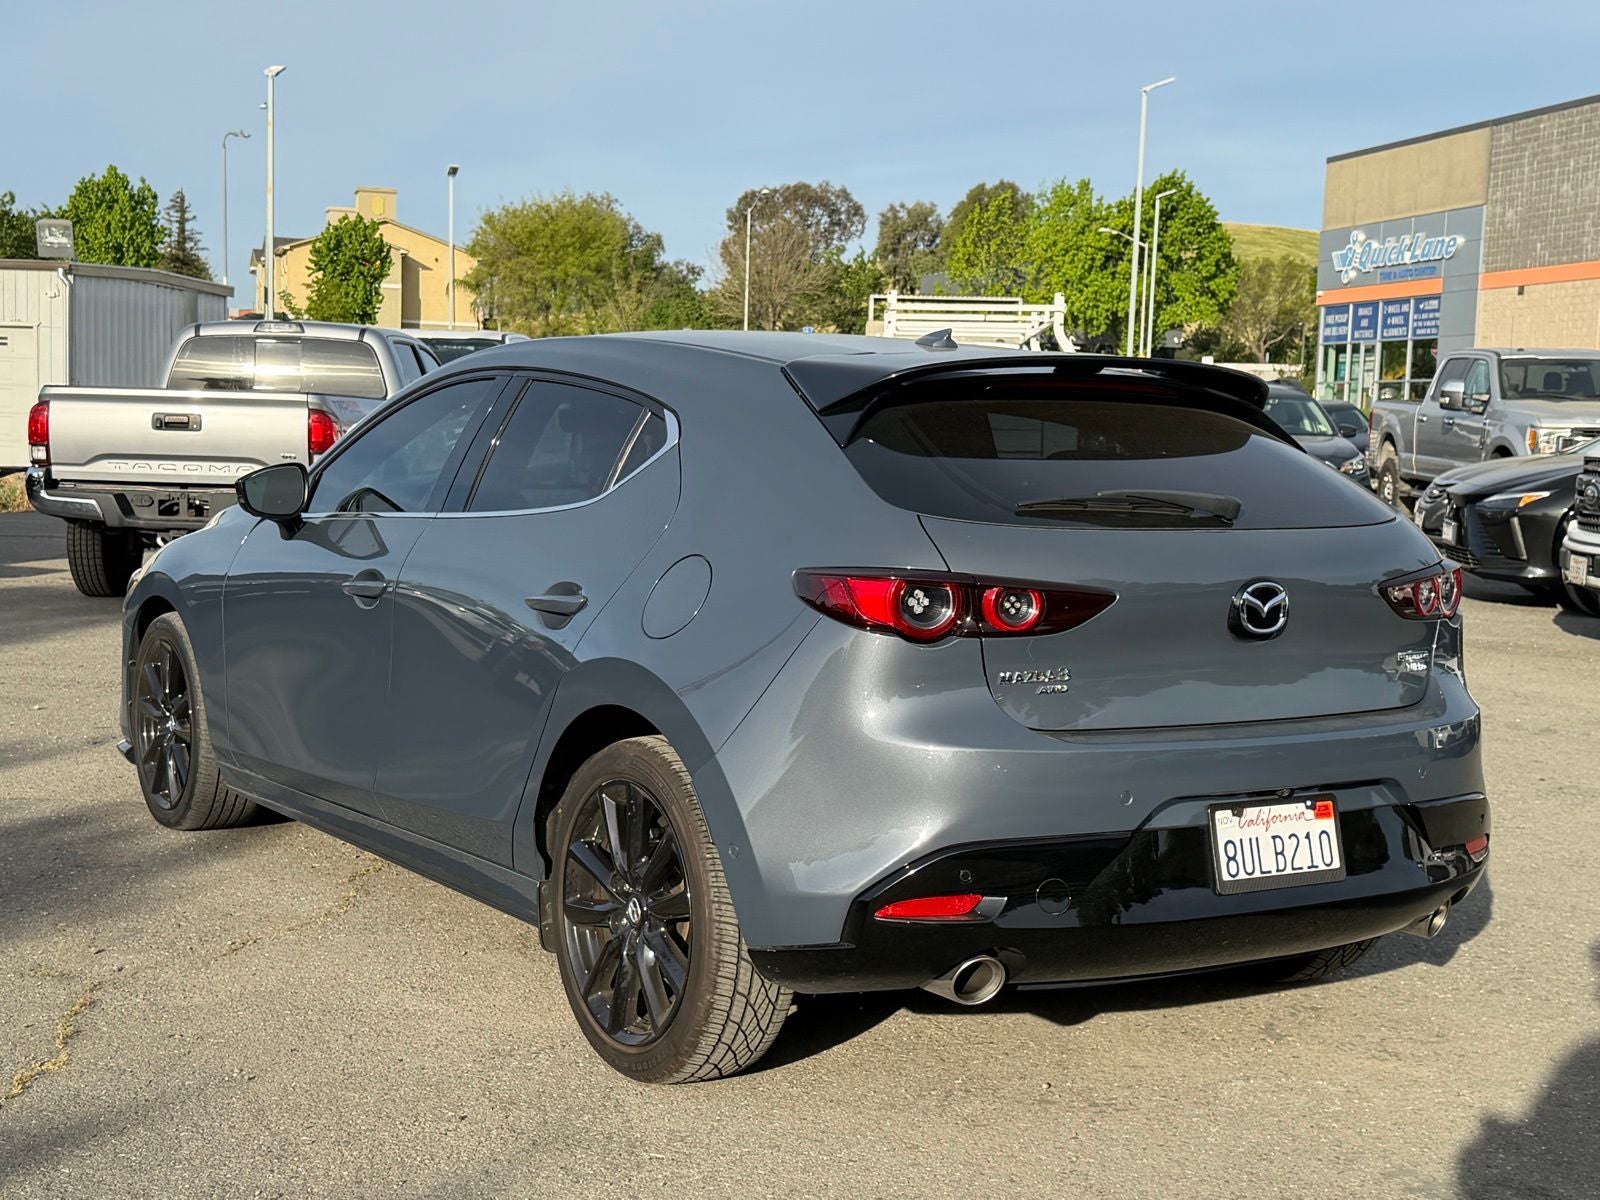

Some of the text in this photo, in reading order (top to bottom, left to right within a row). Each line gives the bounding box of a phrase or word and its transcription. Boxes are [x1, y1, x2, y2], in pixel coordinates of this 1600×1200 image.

[1360, 233, 1458, 272] Quick Lane
[107, 461, 257, 475] TACOMA
[1217, 816, 1233, 826] NOV
[1238, 807, 1314, 832] California
[1223, 830, 1334, 879] 8ULB210
